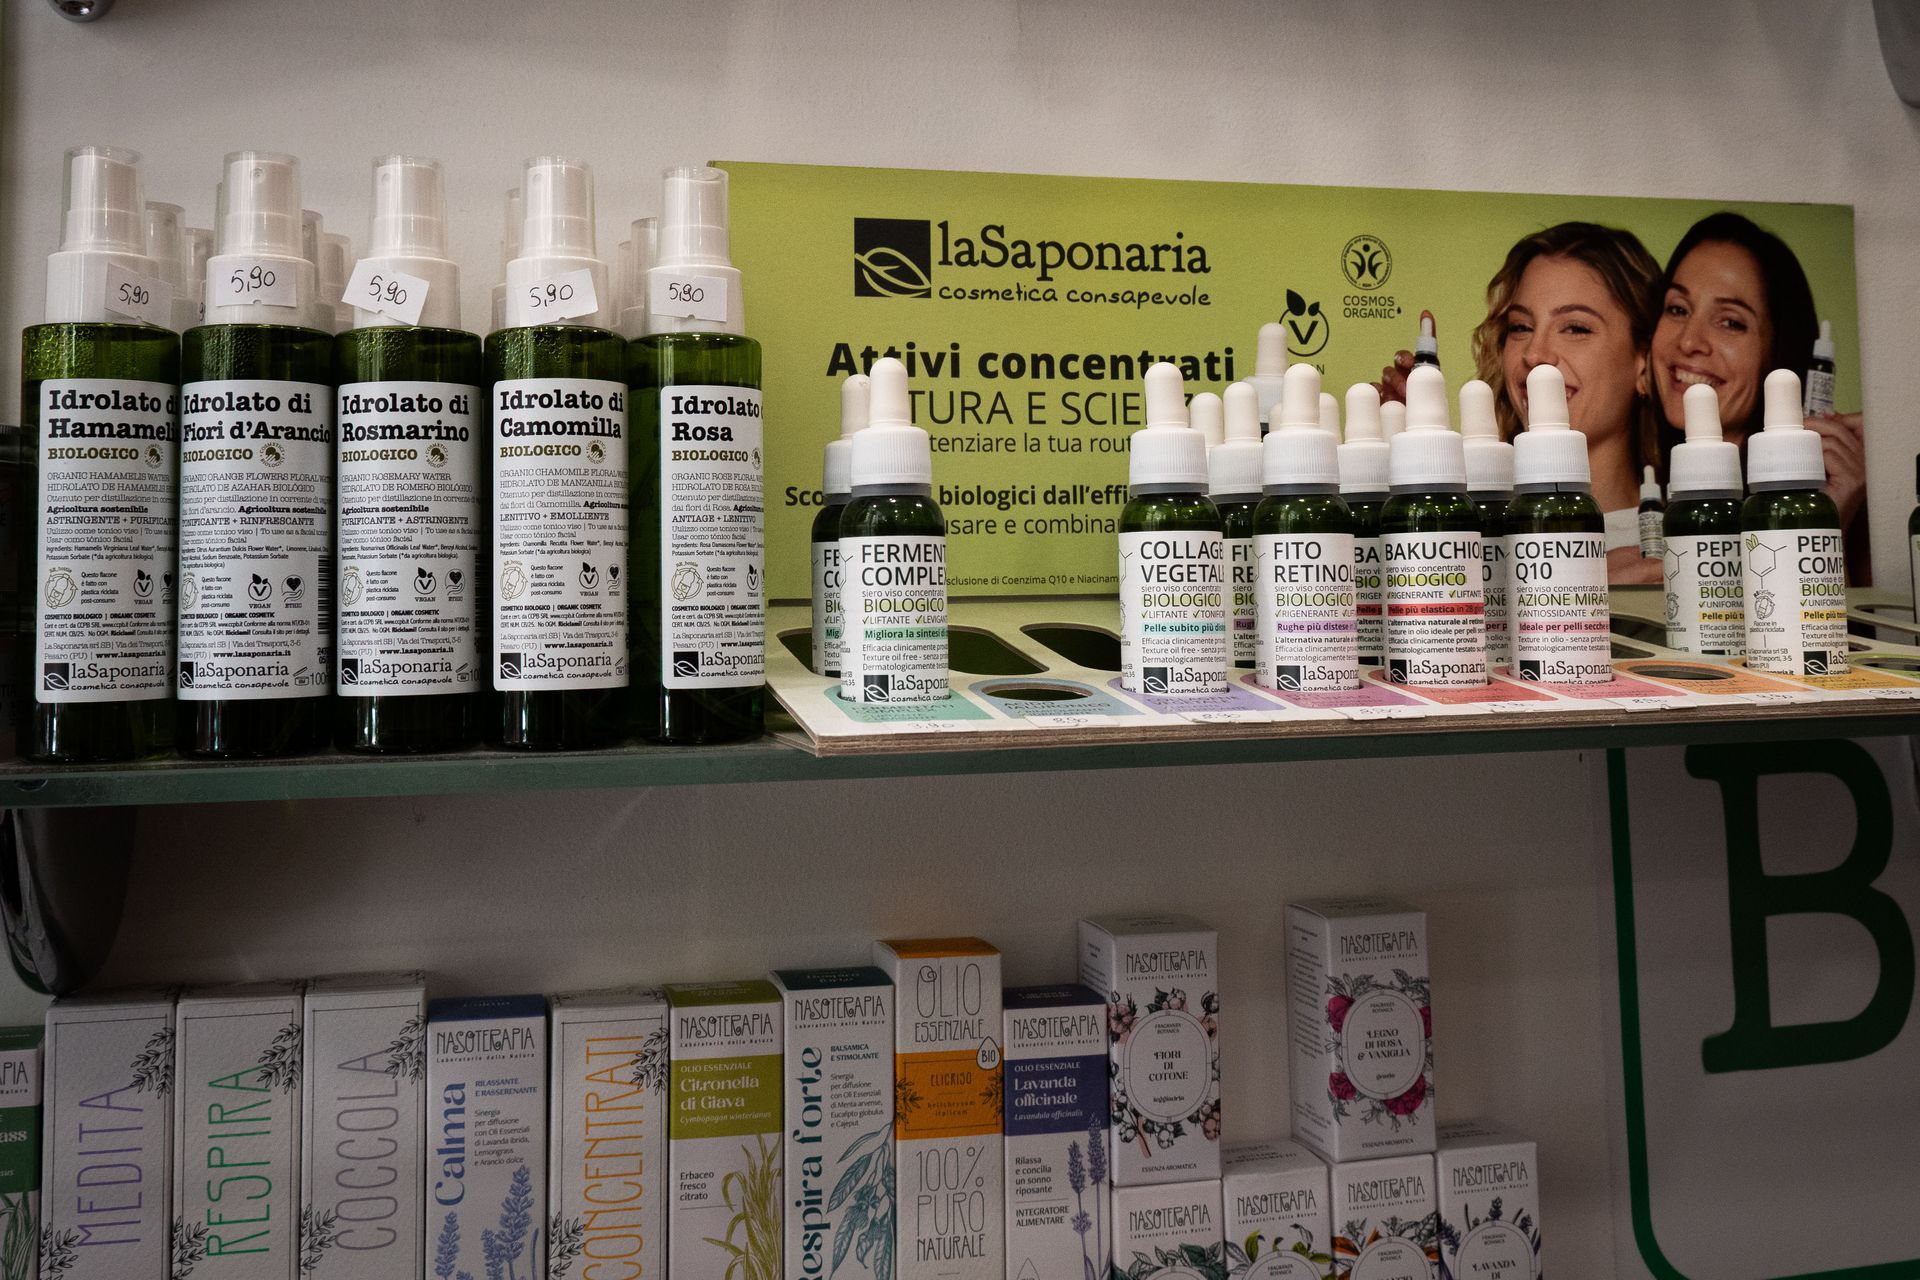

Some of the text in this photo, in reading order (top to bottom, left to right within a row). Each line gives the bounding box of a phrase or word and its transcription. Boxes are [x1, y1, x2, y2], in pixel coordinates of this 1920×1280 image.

[937, 220, 1211, 282] laSaponaria
[231, 265, 275, 293] 5,90
[118, 283, 149, 305] 5,90
[368, 275, 407, 305] 5,90
[530, 283, 574, 307] 5,90
[669, 282, 704, 303] 5,90
[938, 283, 1211, 309] cosmetica consapevole
[1343, 296, 1394, 306] COSMOS
[1343, 308, 1395, 318] ORGANIC
[978, 347, 1235, 382] concentati
[49, 389, 161, 412] Idrolato
[183, 392, 311, 415] Idrolato di
[342, 393, 469, 415] Idrolato di
[500, 389, 623, 412] Idrolato di
[672, 396, 759, 418] Idrolato
[909, 390, 1146, 426] TURA E SCIE
[183, 420, 331, 443] Fiori d'Arancio
[342, 420, 469, 442] Rosmarino
[500, 416, 621, 439] Camomilla
[672, 422, 733, 441] Rosa
[930, 432, 1131, 453] tenziare la tua rout
[48, 448, 139, 460] BIOLOGICO
[182, 449, 252, 463] BIOLOGICO
[342, 449, 417, 462] BIOLOGICO
[500, 445, 581, 458] BIOLOGICO
[672, 450, 748, 462] BIOLOGICO
[90, 472, 146, 480] HAMAMELIS
[208, 473, 244, 481] ORANGE
[785, 486, 824, 506] Sco
[939, 485, 1128, 511] biologici dall'effi
[47, 505, 98, 514] Agricoltura
[550, 512, 609, 520] EMOLLIENTE
[240, 517, 314, 525] RINFRESCANTE
[672, 515, 715, 523] ANTIAGE
[1005, 519, 1016, 534] e
[1024, 514, 1119, 534] combina
[1274, 542, 1321, 560] FITO
[1386, 542, 1482, 560] BAKUCHIO
[1798, 536, 1843, 552] PEPTI
[1141, 565, 1224, 583] VEGETAL
[1275, 565, 1355, 582] RETINOL
[1516, 562, 1552, 583] Q10
[1697, 561, 1742, 577] COM
[1798, 557, 1843, 574] COMP
[946, 576, 988, 586] sclusione
[991, 576, 999, 584] di
[1002, 576, 1046, 584] Coenzima
[1049, 575, 1067, 586] Q10
[1078, 575, 1118, 583] Niacinam
[1387, 573, 1466, 587] BIOLOGICO
[865, 598, 944, 612] BIOLOGICO
[1144, 593, 1220, 607] BIOLOGICO
[1277, 593, 1353, 607] BIOLOGICO
[1518, 594, 1570, 606] AZIONE
[870, 616, 910, 624] LIFTANTE
[1149, 610, 1187, 618] LIFTANTE
[865, 629, 914, 640] Migliora la
[1170, 624, 1199, 632] subito
[1202, 624, 1214, 633] più
[1278, 623, 1321, 633] Rughe più
[213, 650, 291, 658] www.lasaponaria.it
[523, 652, 611, 671] laSaponaria
[72, 661, 164, 682] laSaponaria
[195, 662, 289, 680] laSaponaria
[360, 658, 452, 677] laSaponaria
[235, 680, 289, 689] consapevole
[1684, 738, 1915, 1073] B
[1341, 931, 1417, 955] NASOTERAPIA
[1126, 950, 1207, 974] NASOTERAPIA
[917, 963, 981, 1018] OLIO
[795, 995, 885, 1020] NASOTERAPIA
[680, 1013, 773, 1039] NASOTERAPIA
[915, 1019, 984, 1042] ESSENZIALE
[1013, 1015, 1099, 1040] NASOTERAPIA
[1366, 1029, 1399, 1038] LEGNO
[437, 1028, 535, 1054] NASOTERAPIA
[831, 1044, 868, 1052] BALSAMICA
[837, 1053, 879, 1061] STIMOLANTE
[982, 1050, 995, 1062] BIO
[1154, 1050, 1181, 1060] FIORI
[704, 1062, 752, 1071] ESSENZIALE
[1036, 1062, 1080, 1071] ESSENZIALE
[1164, 1062, 1173, 1070] DI
[476, 1078, 519, 1086] RILASSANTE
[681, 1076, 759, 1092] Citronella
[1015, 1076, 1076, 1090] Lavanda
[1149, 1071, 1188, 1082] COTONE
[680, 1096, 744, 1110] di Giava
[793, 1046, 823, 1144] forte
[1015, 1092, 1077, 1107] officinale
[335, 1050, 398, 1250] COCCOLA
[435, 1082, 466, 1206] Calma
[77, 1084, 144, 1246] MEDITA
[207, 1064, 272, 1256] RESPIRA
[1016, 1156, 1041, 1164] Rilassa
[680, 1172, 714, 1180] Erbaceo
[916, 1146, 984, 1192] 100%
[1023, 1166, 1051, 1174] concilia
[1453, 1162, 1528, 1187] NASOTERAPIA
[680, 1182, 706, 1190] fresco
[1016, 1186, 1052, 1196] riposante
[1348, 1176, 1425, 1203] NASOTERAPIA
[680, 1193, 708, 1201] citrato
[1238, 1190, 1316, 1217] NASOTERAPIA
[795, 1155, 831, 1280] espira
[918, 1191, 984, 1236] PURO
[1016, 1206, 1070, 1217] INTEGRATORE
[1129, 1204, 1210, 1232] NASOTERAPIA
[1016, 1216, 1064, 1227] ALIMENTARE
[918, 1234, 985, 1262] NATURALE
